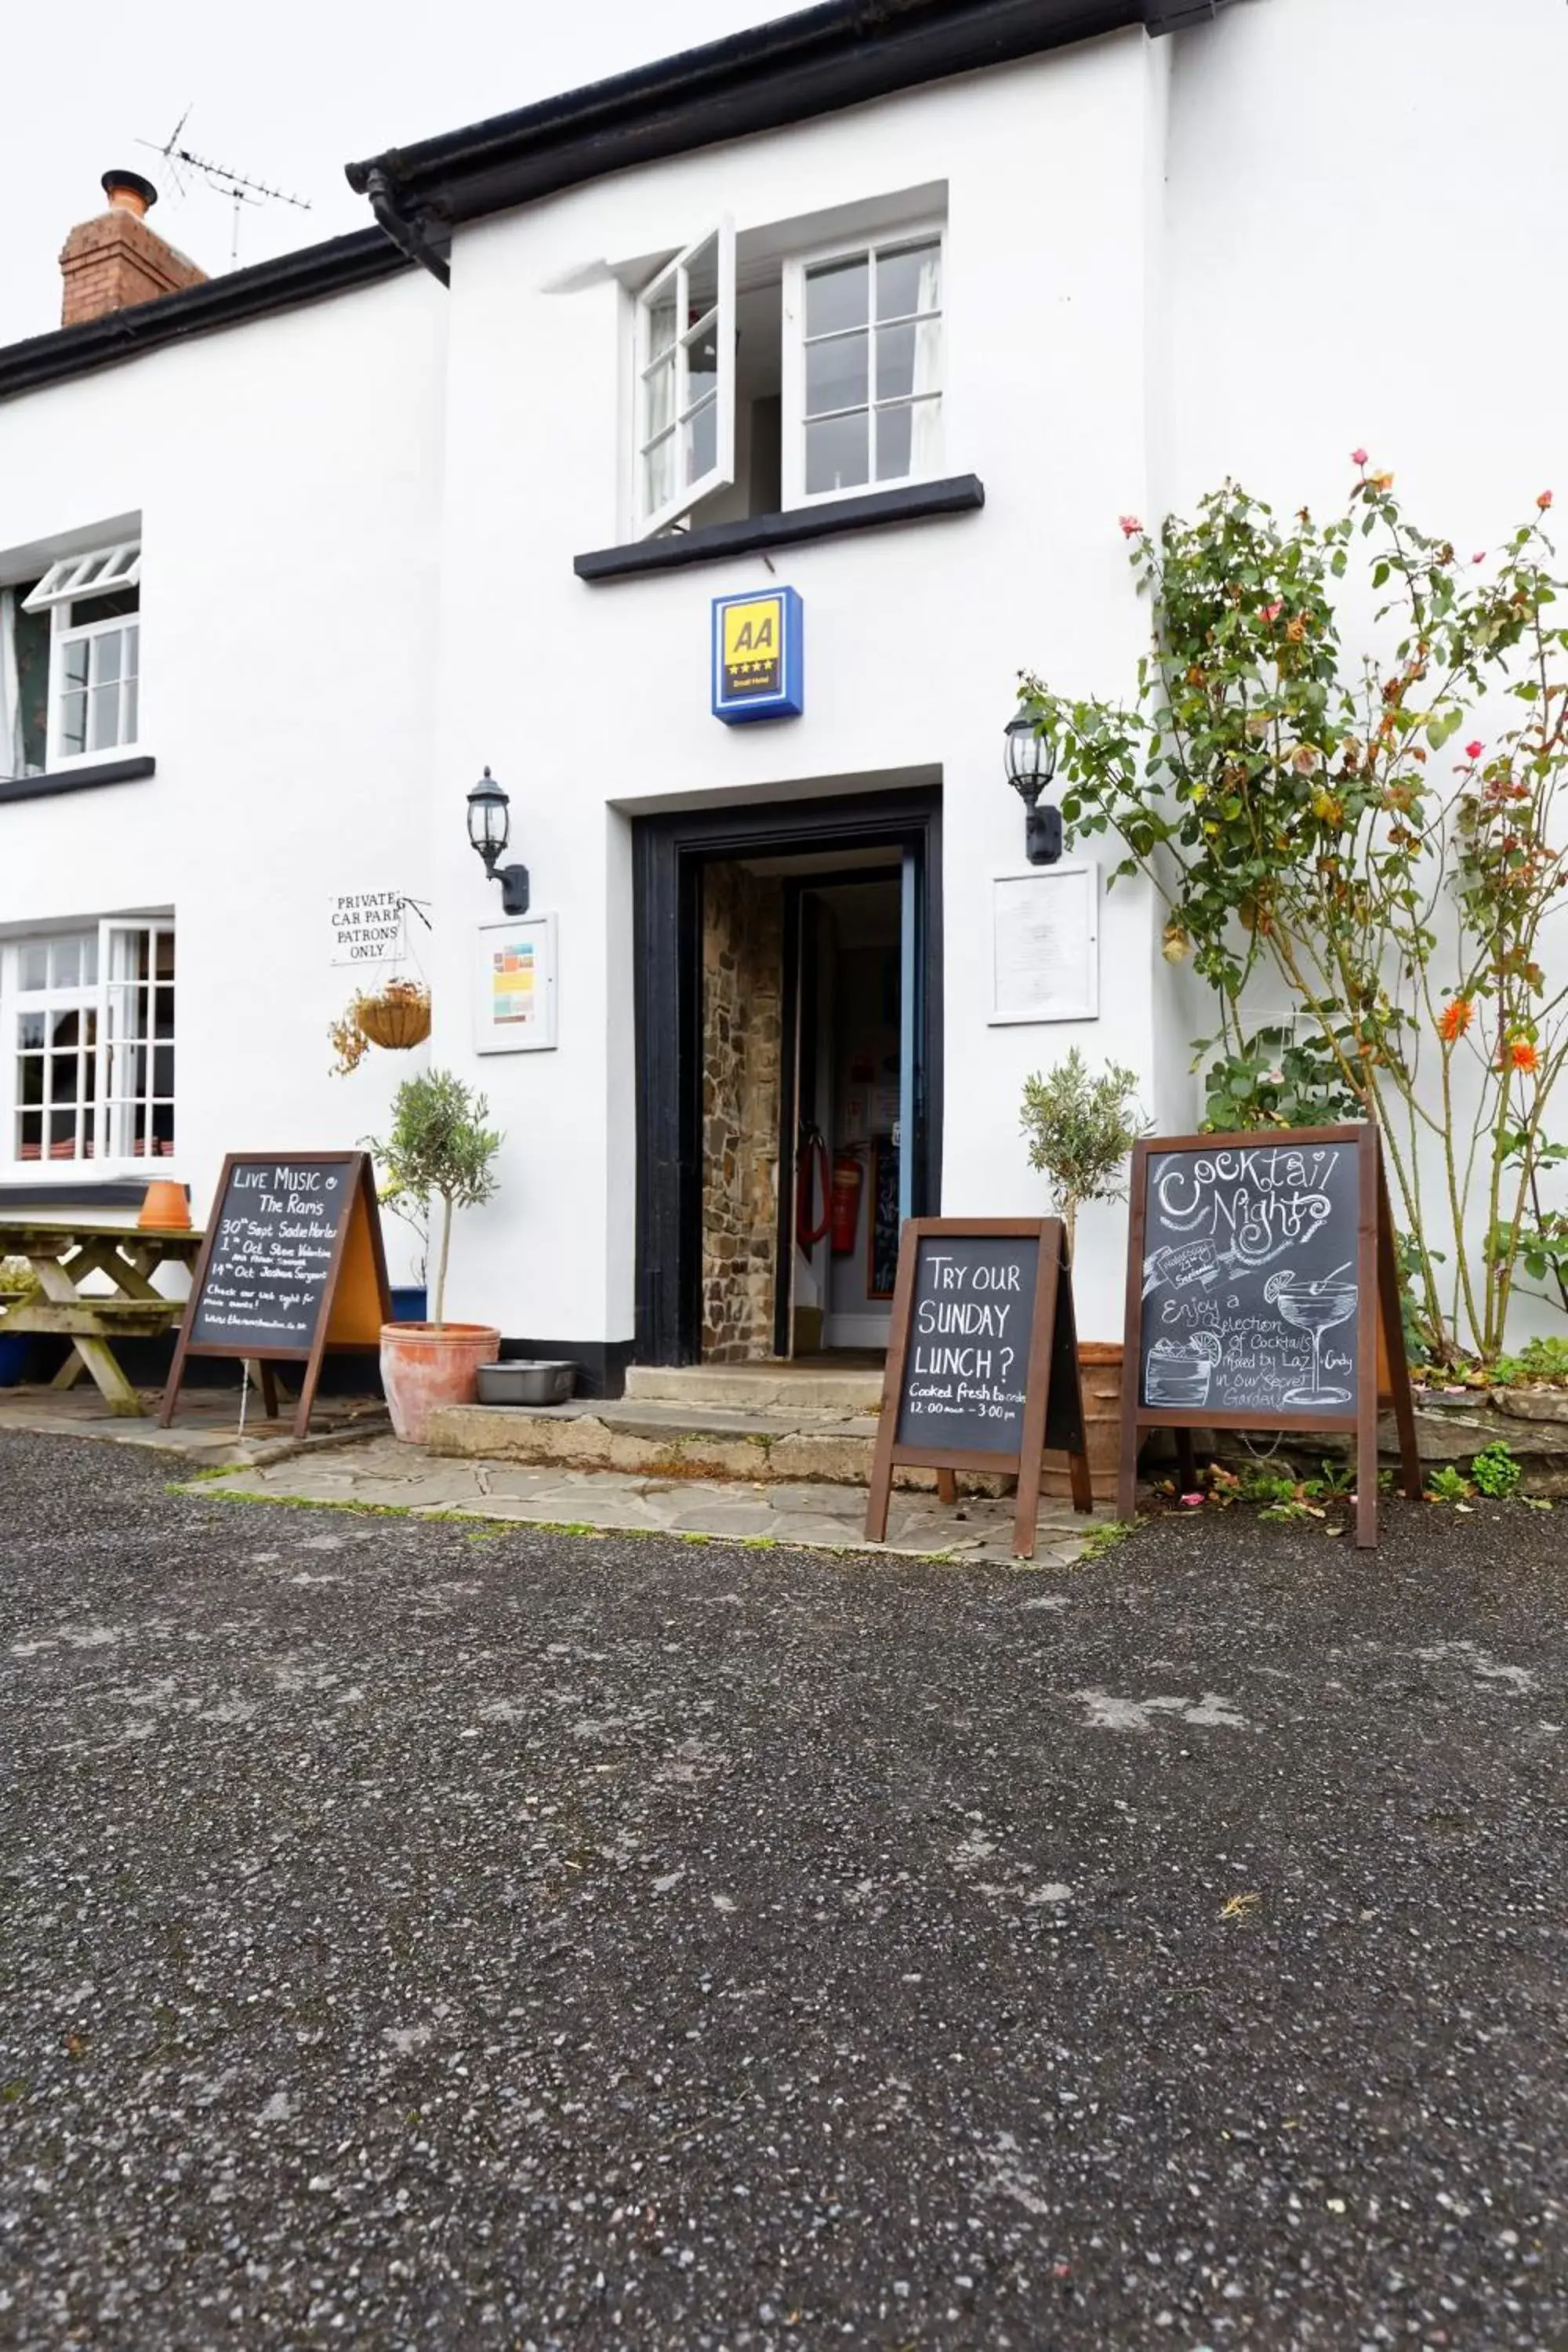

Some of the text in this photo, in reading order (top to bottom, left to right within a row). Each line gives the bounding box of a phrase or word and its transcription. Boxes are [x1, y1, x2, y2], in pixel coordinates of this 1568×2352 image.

[733, 618, 772, 652] AA
[338, 892, 395, 909] PRIVATE
[332, 909, 401, 926] CAR PARK
[338, 926, 397, 943] PATRONS
[350, 944, 384, 959] ONLY
[260, 1194, 283, 1213] The
[247, 1221, 274, 1239] Sept
[242, 1240, 263, 1254] Oct
[235, 1265, 255, 1279] Oct
[926, 1257, 1021, 1292] TRY OUR
[918, 1299, 1011, 1338] SUNDAY
[1162, 1294, 1240, 1327] Enjoy a
[1250, 1334, 1312, 1352] Cocktails
[909, 1382, 953, 1398] Cooked
[956, 1381, 990, 1403] fresh
